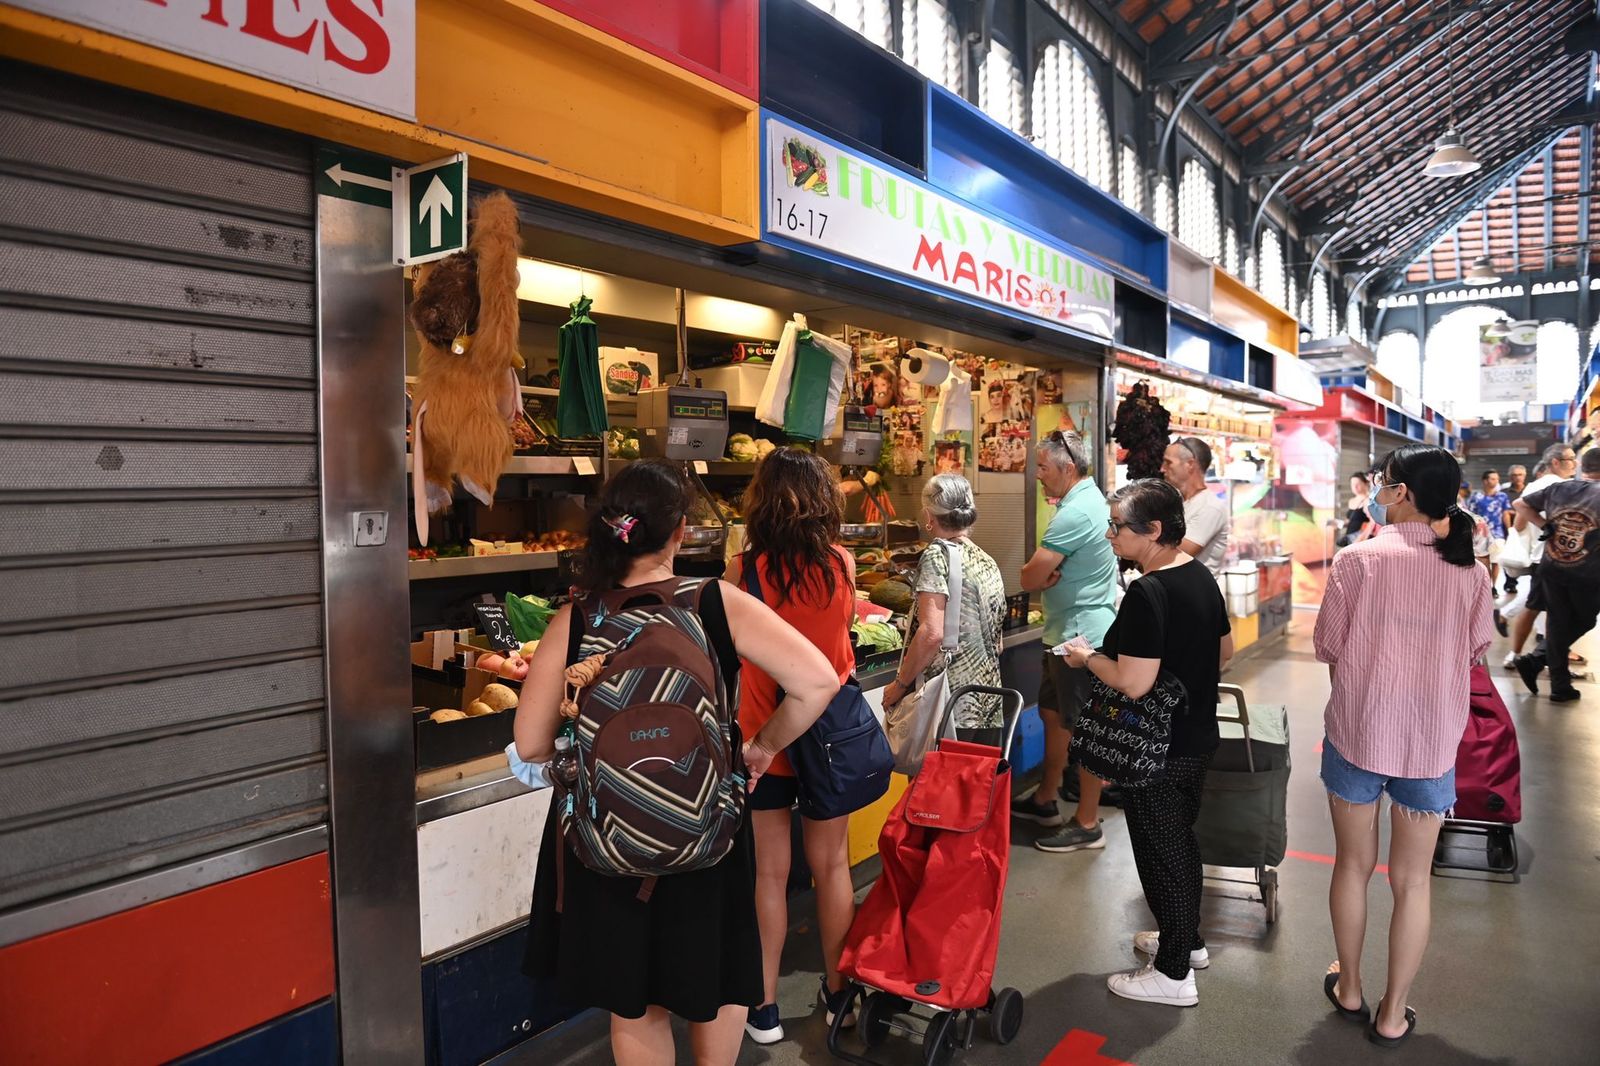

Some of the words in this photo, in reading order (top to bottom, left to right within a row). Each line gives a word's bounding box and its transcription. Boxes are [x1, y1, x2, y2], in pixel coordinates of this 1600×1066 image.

[836, 155, 968, 246] FRUTAS
[776, 197, 829, 240] 16-17
[1559, 534, 1577, 549] 66
[630, 726, 670, 742] DAKINE
